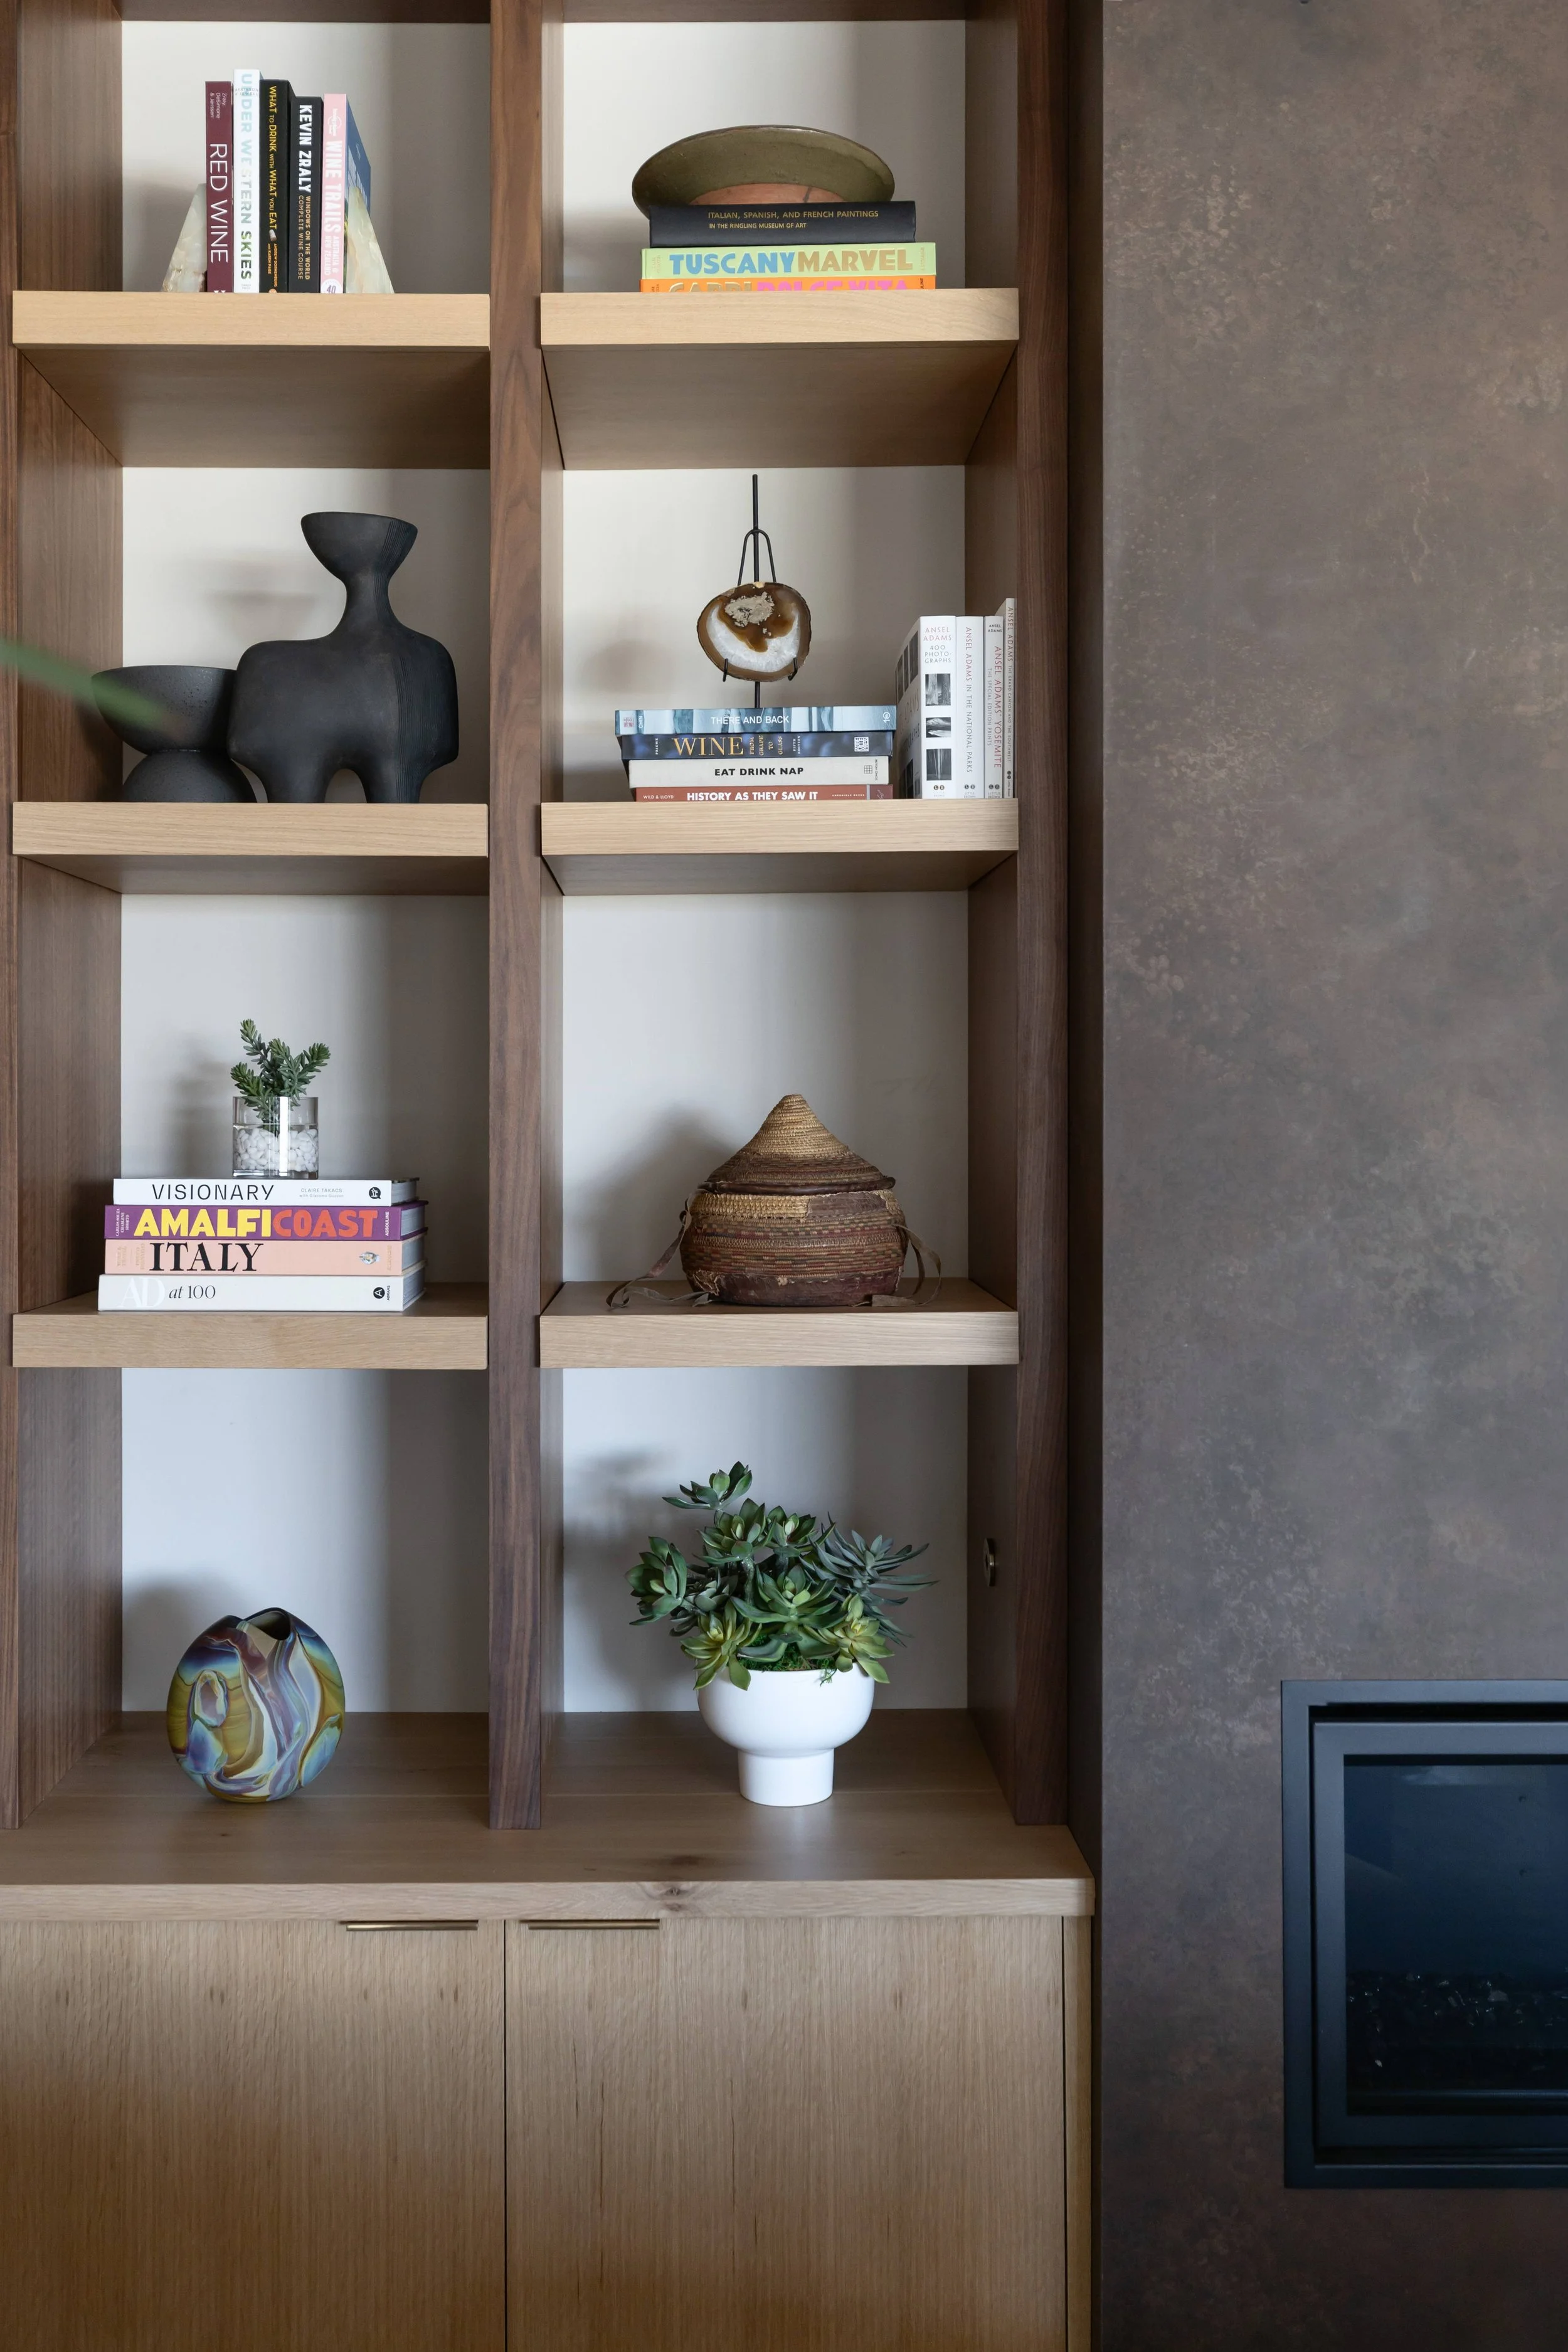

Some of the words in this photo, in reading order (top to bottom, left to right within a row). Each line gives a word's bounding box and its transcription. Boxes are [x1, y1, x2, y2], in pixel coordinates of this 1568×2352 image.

[241, 74, 252, 133] UNDER
[269, 85, 277, 114] WHAT
[269, 115, 274, 123] TO
[299, 105, 312, 146] KEVIN
[268, 125, 277, 152] DRINK
[210, 144, 227, 191] RED
[299, 151, 312, 193] ZRALY
[325, 140, 342, 177] WINE
[241, 139, 252, 224] WESTERN
[269, 169, 277, 198] WHAT
[269, 212, 277, 230] EAT
[324, 183, 342, 233] TRAILS
[211, 199, 228, 263] WINE
[305, 230, 310, 240] ON
[241, 231, 252, 280] SKIES
[711, 716, 740, 725] THERE
[743, 716, 763, 724] AND
[765, 715, 789, 724] BACK
[671, 736, 744, 756] WINE
[768, 741, 773, 750] TO
[994, 721, 1002, 768] YOSEMITE
[687, 792, 731, 801] HISTORY
[735, 792, 749, 800] AS
[752, 792, 778, 800] THEY
[781, 792, 806, 800] SAW
[809, 792, 818, 800] IT
[152, 1184, 274, 1200] VISIONARY
[149, 1242, 264, 1273] ITALY
[117, 1277, 166, 1308] AD
[169, 1286, 184, 1299] at
[187, 1285, 216, 1299] 100
